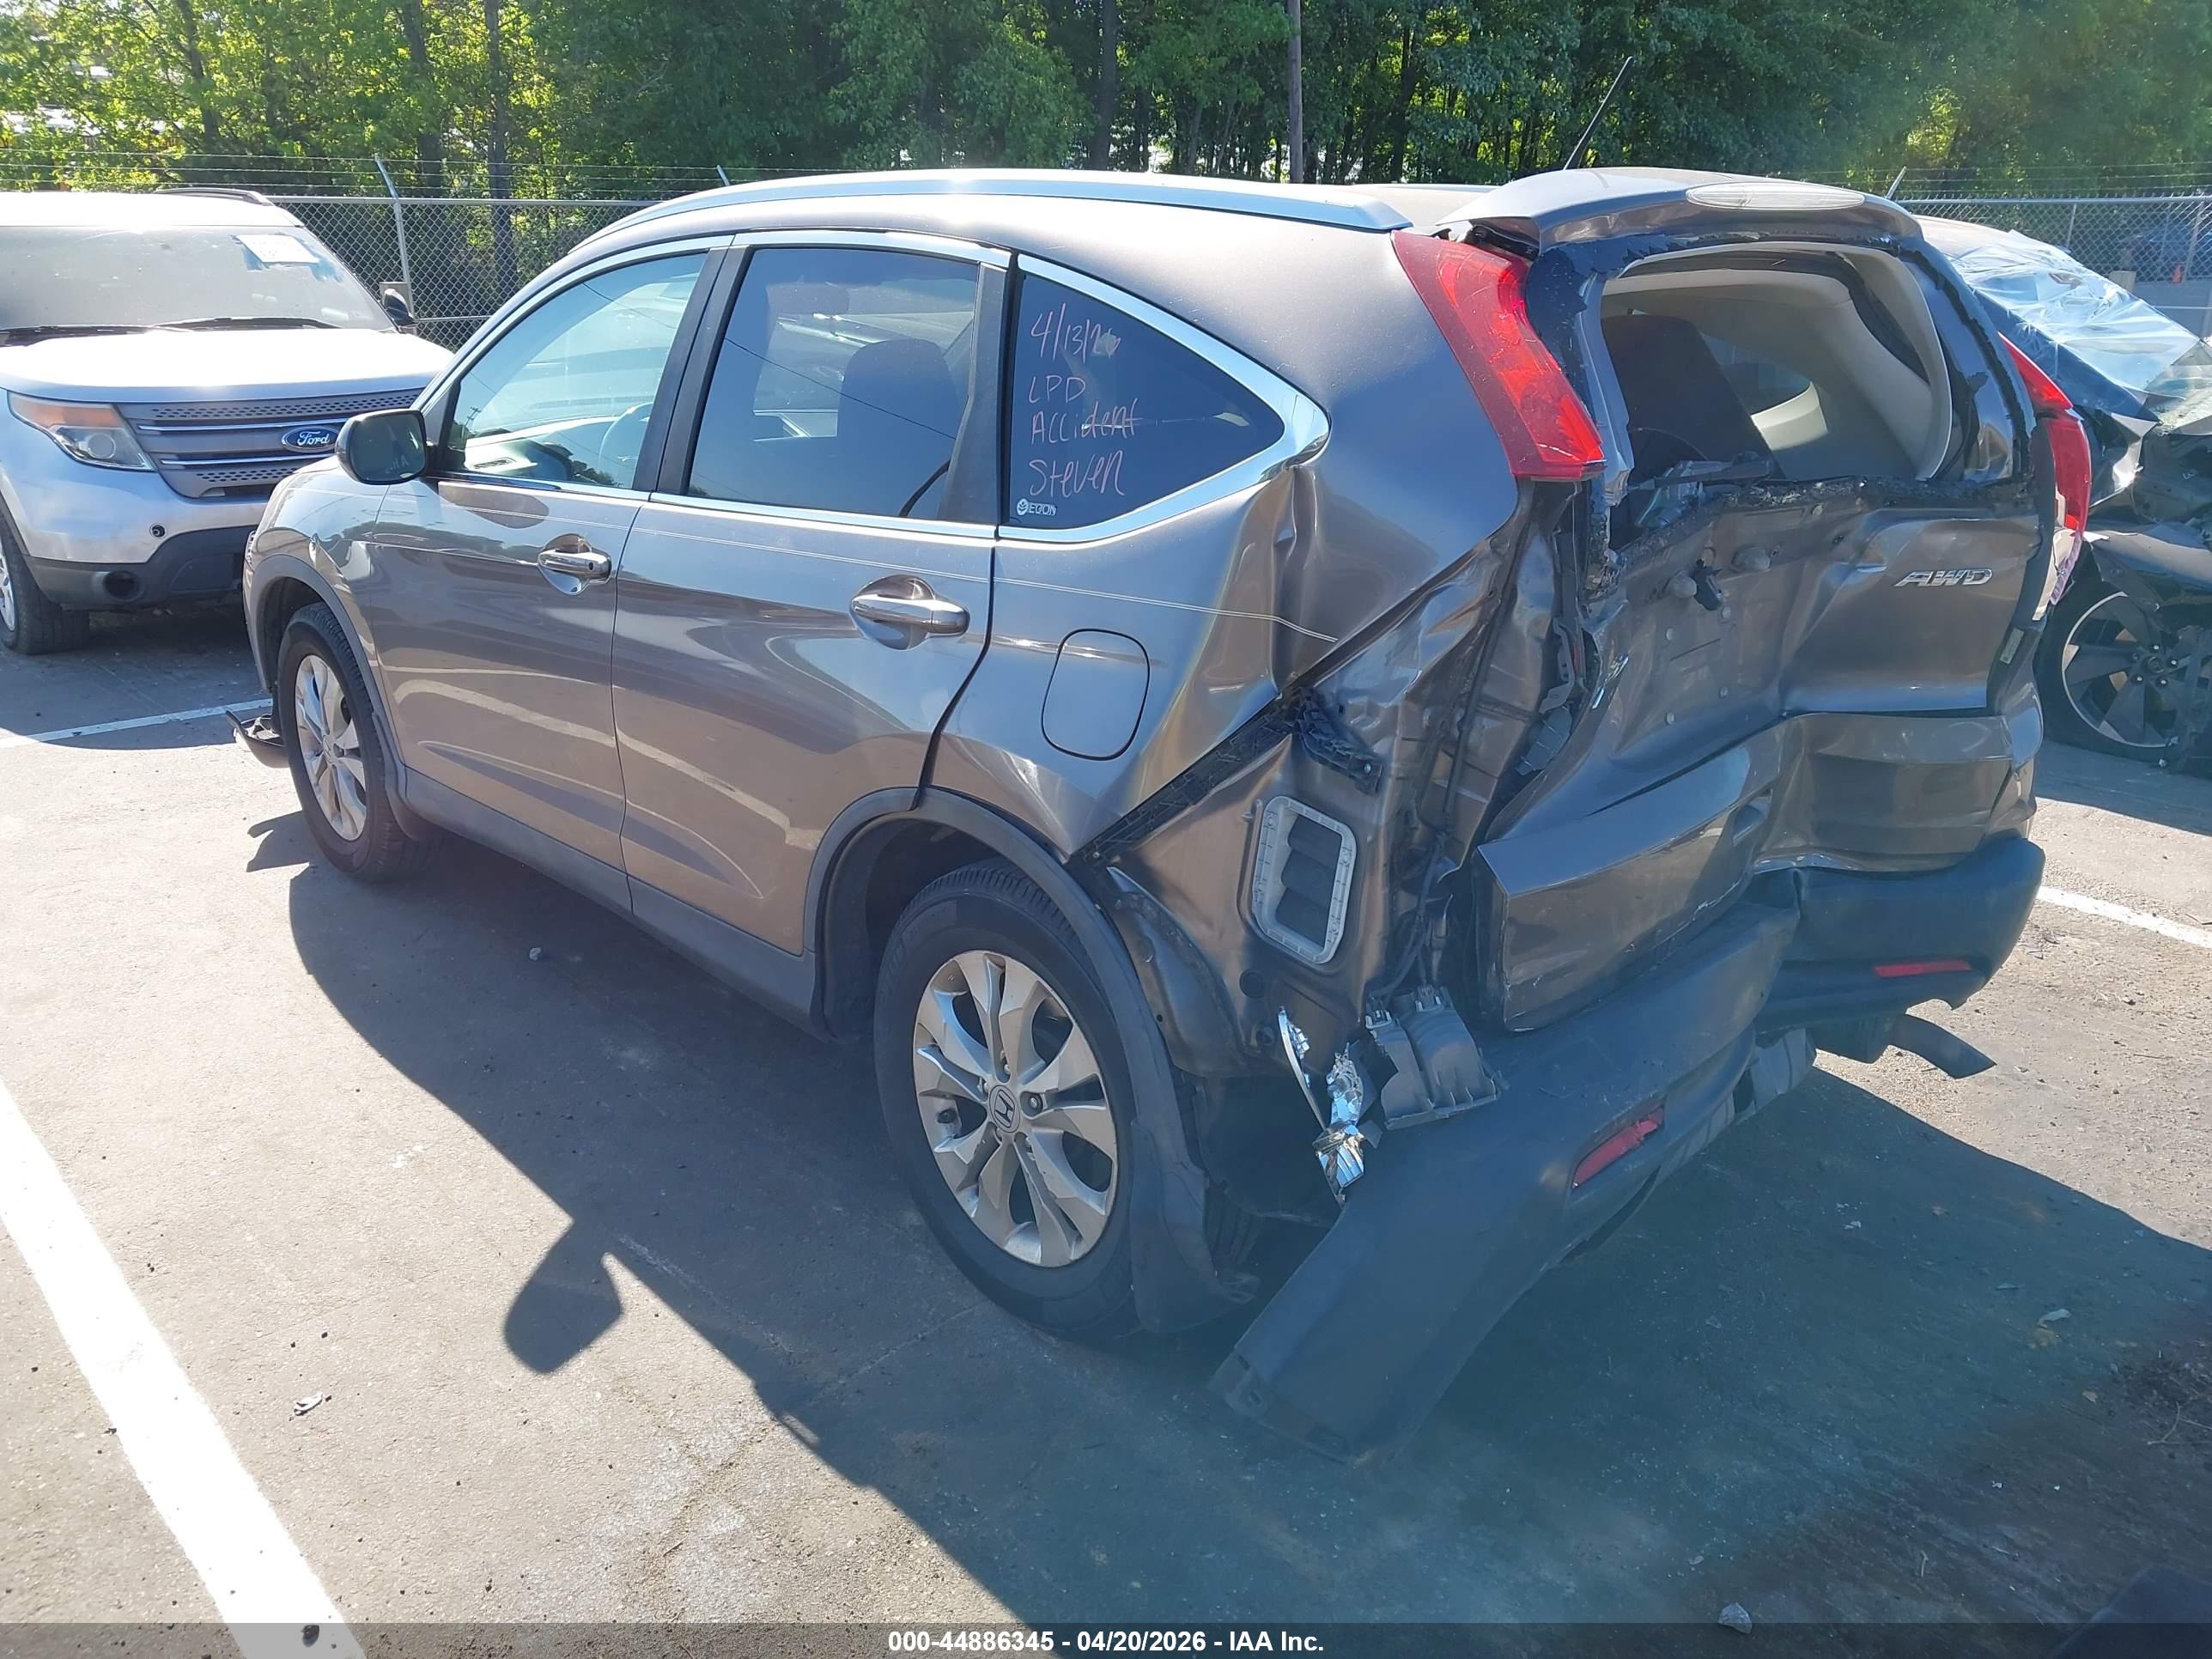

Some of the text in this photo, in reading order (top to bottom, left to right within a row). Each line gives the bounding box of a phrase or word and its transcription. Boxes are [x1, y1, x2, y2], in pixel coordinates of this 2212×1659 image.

[1029, 374, 1086, 404] LPD
[296, 430, 331, 447] Ford
[1029, 449, 1126, 499] Steven
[1893, 568, 1993, 587] AWD
